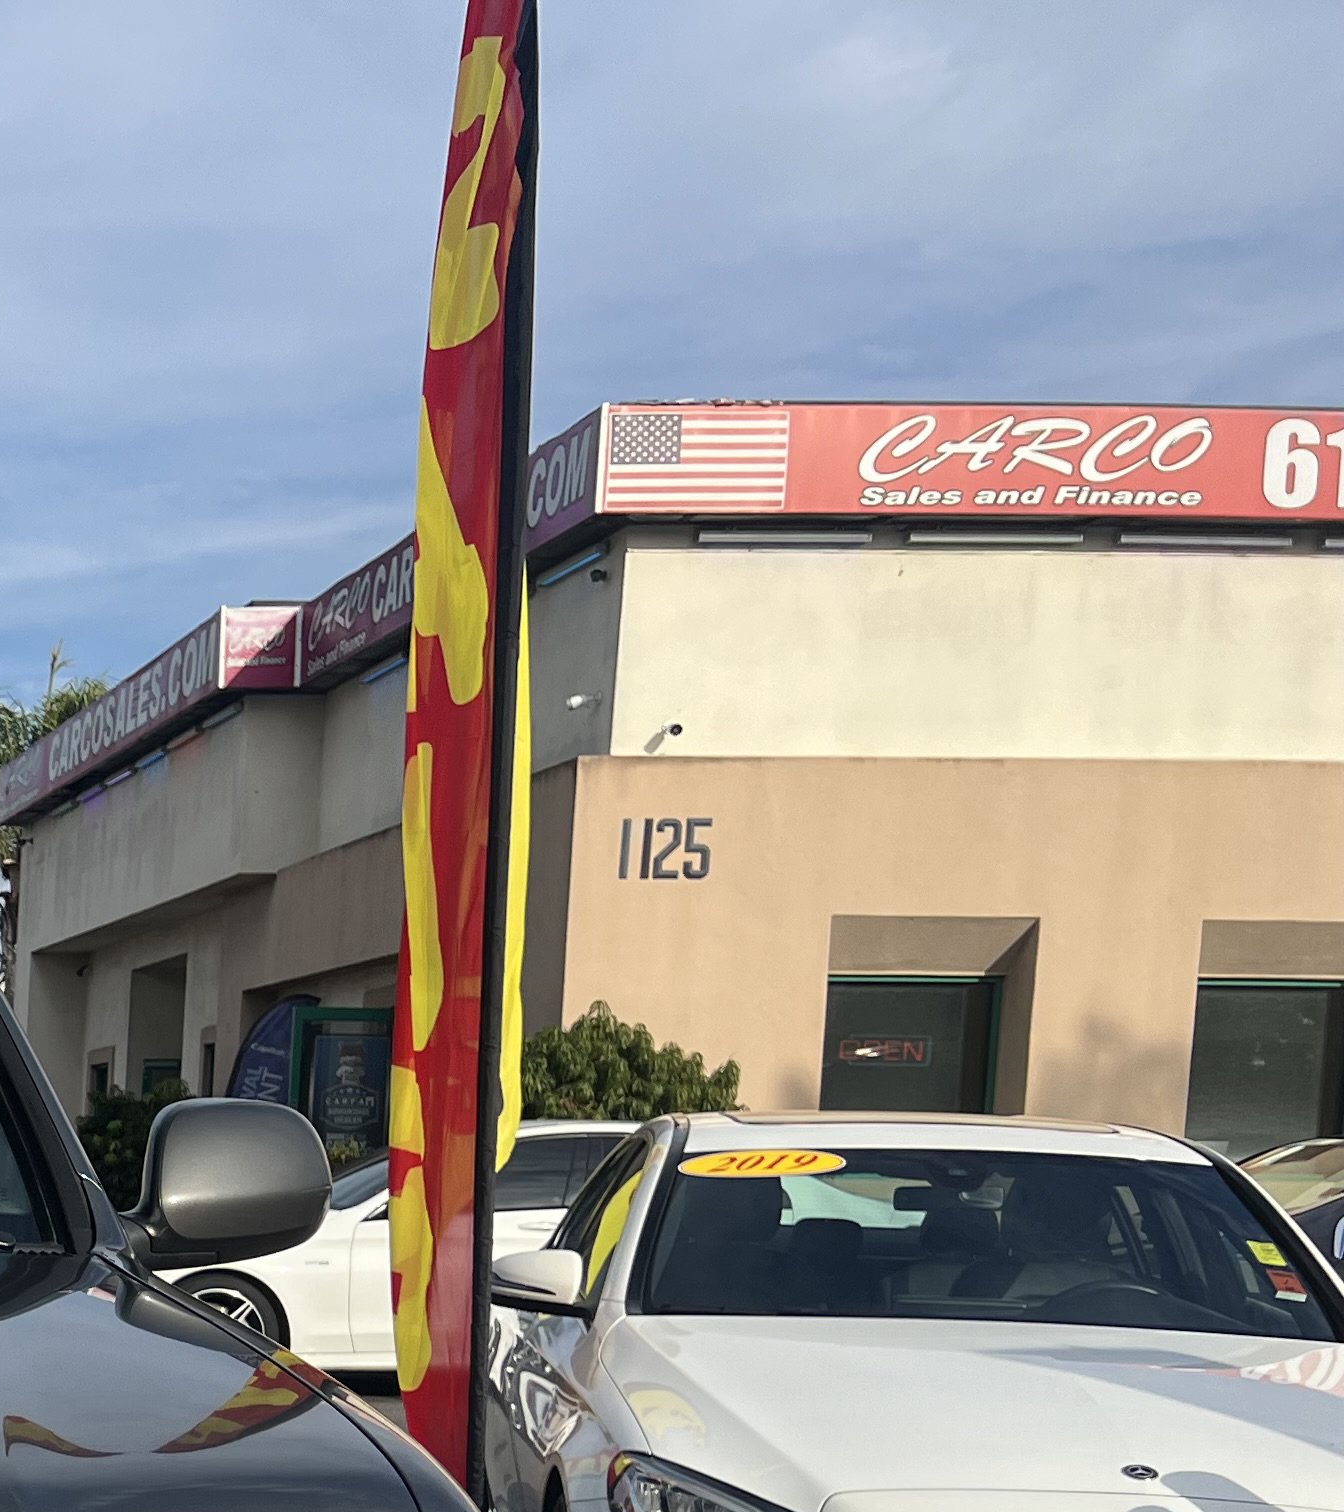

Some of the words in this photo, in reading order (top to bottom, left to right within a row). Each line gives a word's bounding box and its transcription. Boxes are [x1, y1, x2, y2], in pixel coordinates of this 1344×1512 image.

[858, 414, 1213, 483] CARCO
[860, 485, 962, 506] Sales
[973, 485, 1045, 505] and
[1053, 485, 1202, 506] Finance
[48, 622, 218, 782] CARCOSALES.COM
[618, 817, 713, 879] 1125
[839, 1040, 925, 1062] OPEN
[706, 1153, 819, 1173] 2019
